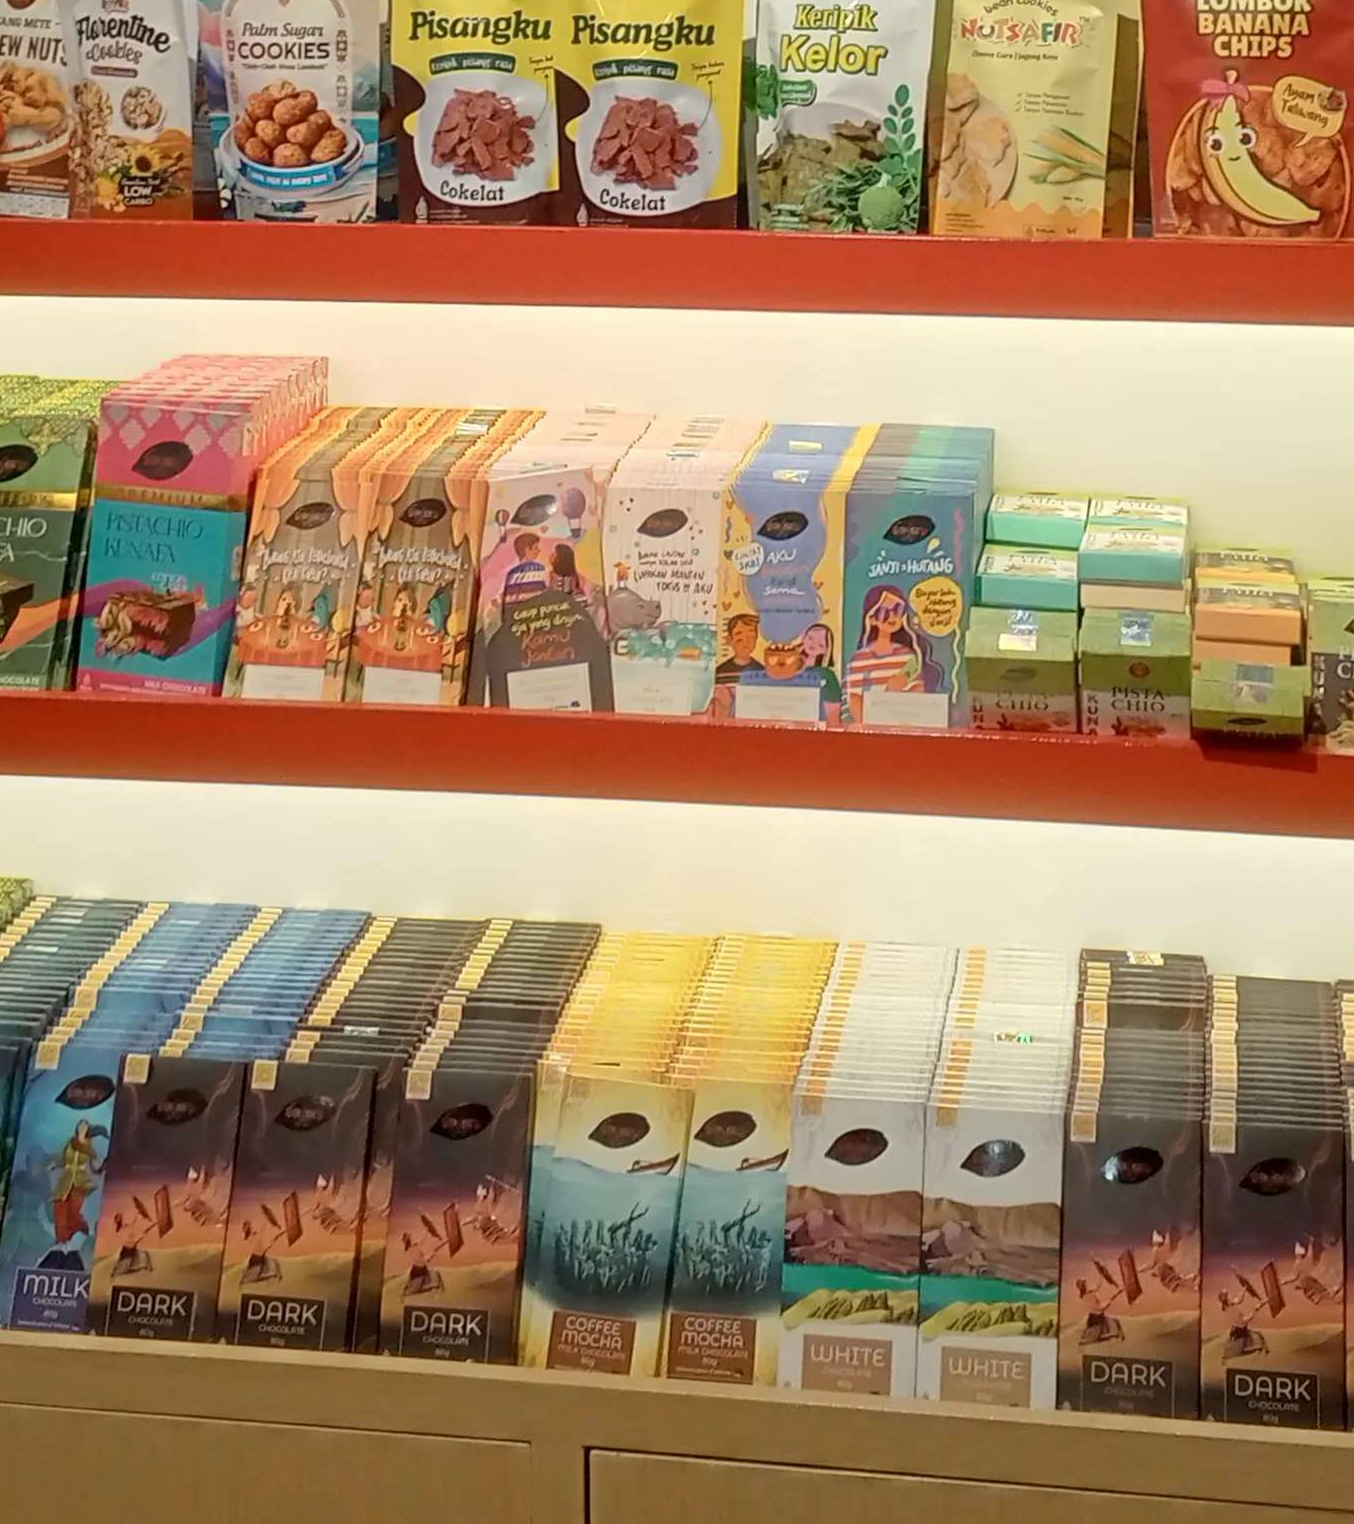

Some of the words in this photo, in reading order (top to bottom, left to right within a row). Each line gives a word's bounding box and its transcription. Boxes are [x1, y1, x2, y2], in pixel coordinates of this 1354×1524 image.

[242, 22, 279, 38] Palm
[281, 22, 325, 39] Sugar
[409, 11, 552, 45] Pisangku
[794, 3, 879, 33] Keripik
[1198, 13, 1310, 37] BANANA
[75, 14, 172, 53] Florentine
[572, 14, 716, 51] Pisangku
[960, 16, 1082, 47] NUTSAFIR
[29, 36, 68, 67] NUTS
[238, 42, 331, 61] COOKIES
[779, 34, 888, 74] Kelor
[1213, 35, 1293, 58] CHIPS
[1282, 85, 1316, 104] Ayam
[1280, 98, 1329, 128] Taliwang
[123, 184, 154, 199] LOW
[440, 179, 506, 202] Cokelat
[599, 187, 666, 212] Cokelat
[105, 511, 204, 540] PISTACHIO
[104, 536, 178, 564] KUNAFA
[766, 548, 797, 565] AKU
[1111, 698, 1166, 714] CHIO
[22, 1275, 90, 1299] MILK
[117, 1290, 188, 1318] DARK
[246, 1299, 319, 1326] DARK
[409, 1310, 483, 1337] DARK
[565, 1315, 621, 1336] COFFEE
[683, 1317, 742, 1335] COFFEE
[561, 1330, 623, 1351] MOCHA
[680, 1330, 744, 1349] MOCHA
[810, 1342, 886, 1368] WHITE
[948, 1356, 1025, 1380] WHITE
[1089, 1360, 1167, 1388] DARK
[1233, 1375, 1312, 1402] DARK
